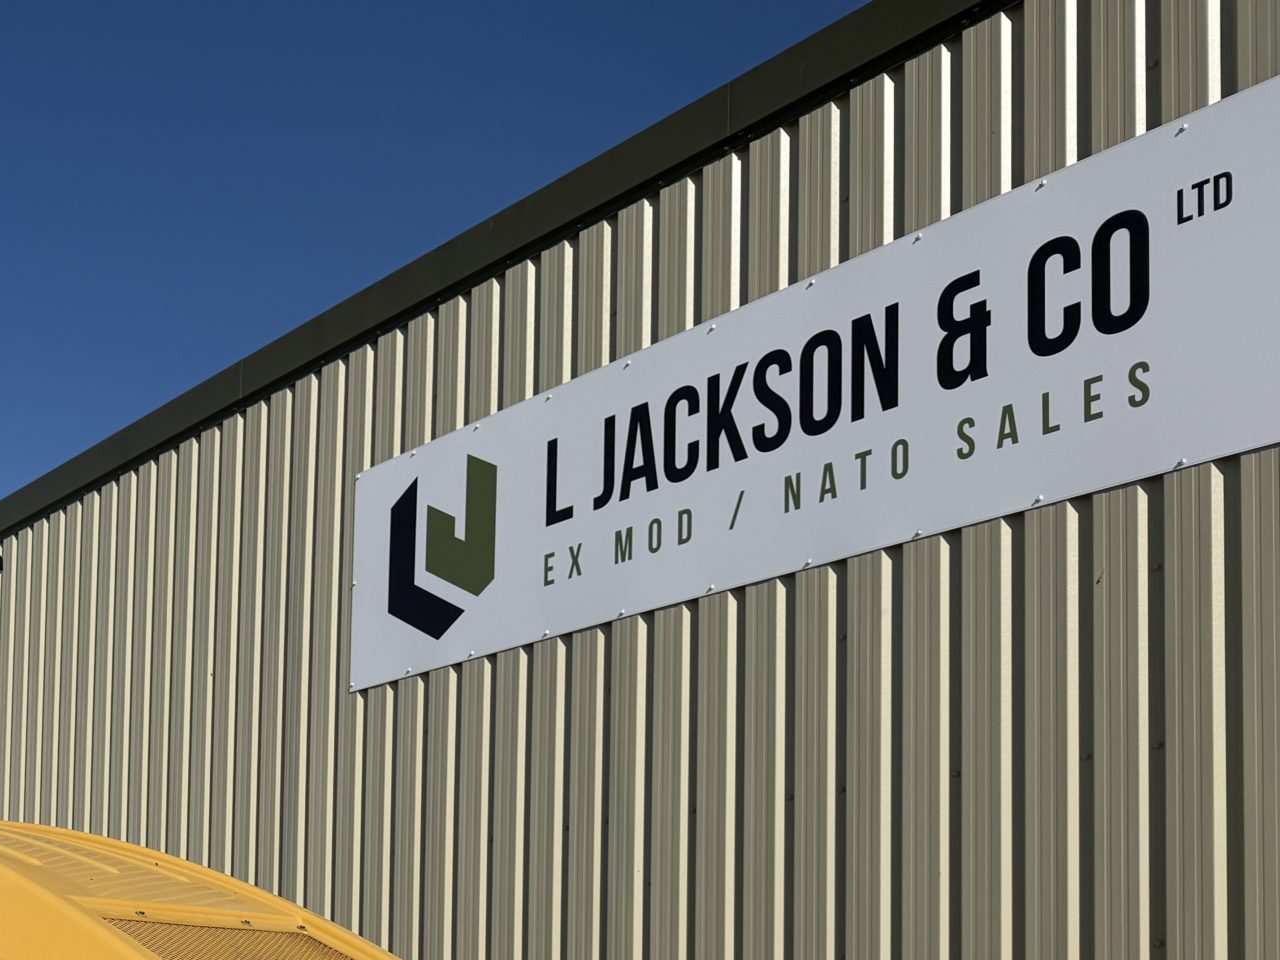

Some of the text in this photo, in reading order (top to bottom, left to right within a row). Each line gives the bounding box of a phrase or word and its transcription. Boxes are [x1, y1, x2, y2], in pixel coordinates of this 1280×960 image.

[543, 542, 583, 587] EX
[614, 508, 693, 565] MOD
[783, 438, 909, 514] NATO
[956, 361, 1151, 460] SALES
[545, 171, 1233, 528] L JACKSON & CO LTD
